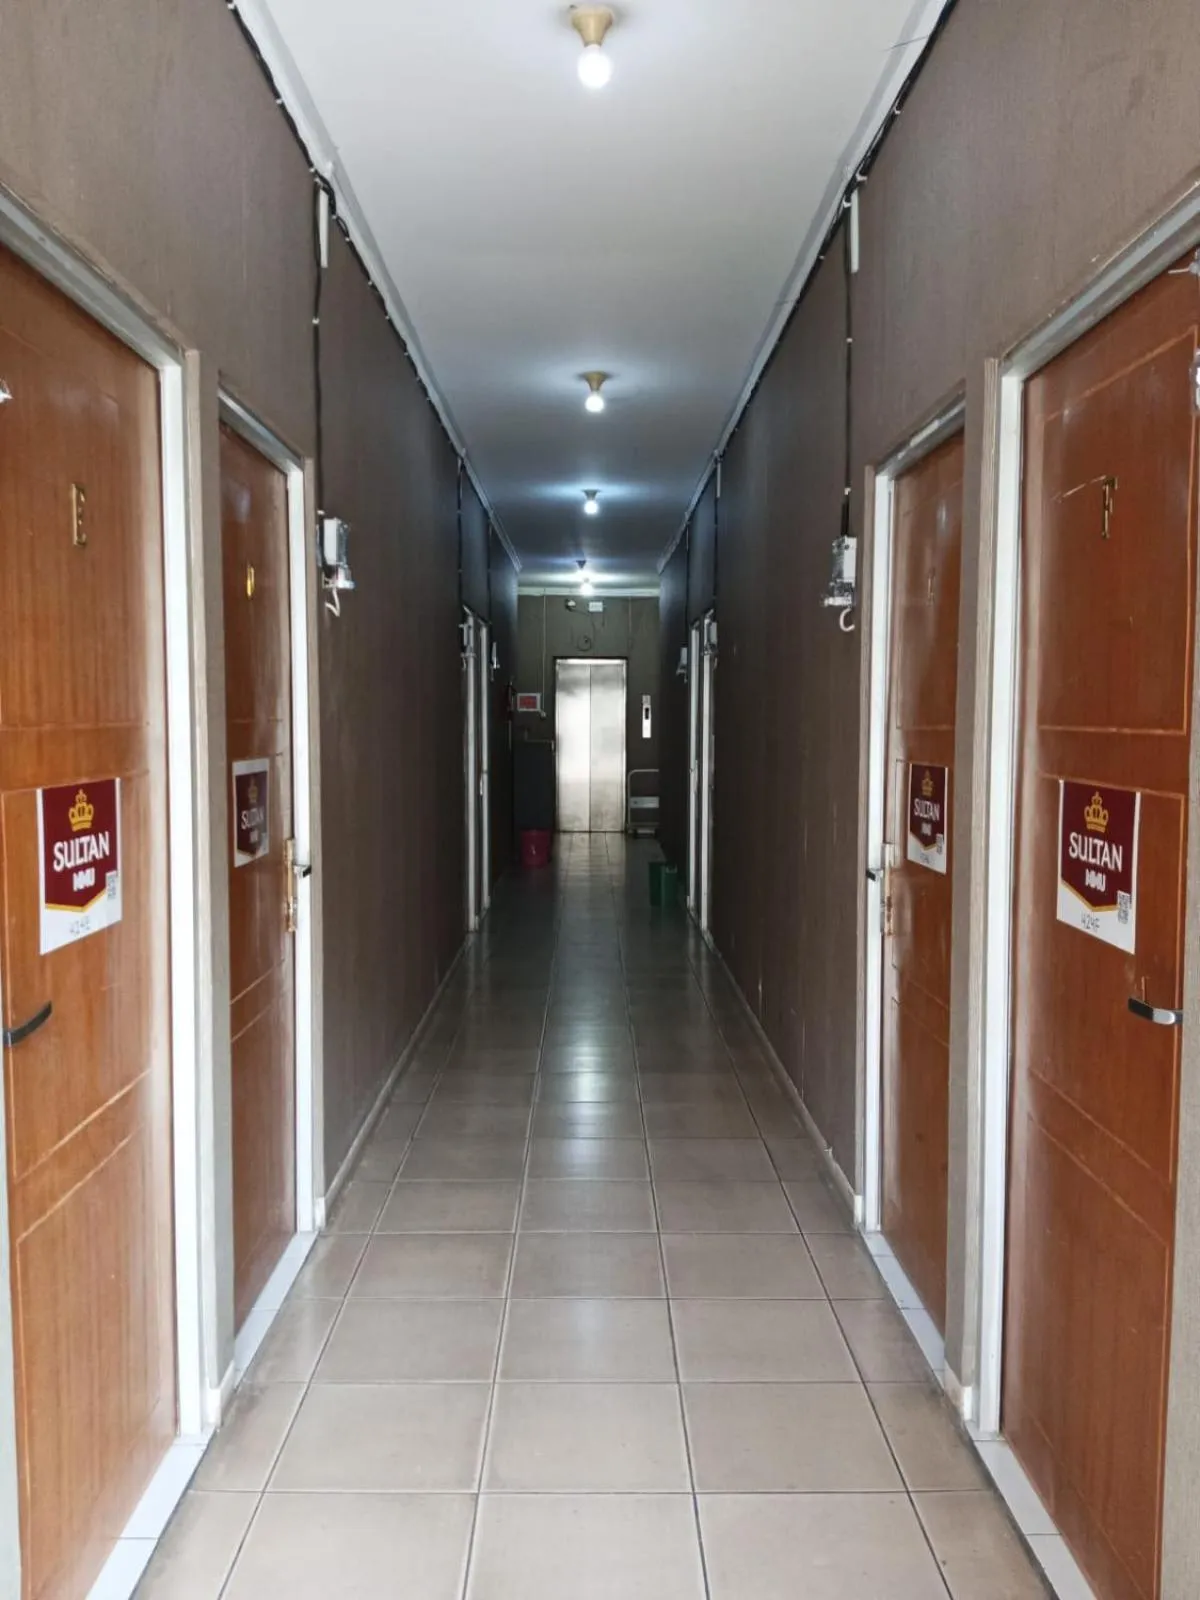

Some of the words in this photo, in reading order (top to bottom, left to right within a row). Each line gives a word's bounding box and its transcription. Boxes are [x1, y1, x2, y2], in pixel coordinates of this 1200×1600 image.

[914, 798, 940, 821] SULTAN
[53, 831, 110, 872] SULTAN
[1069, 831, 1123, 872] SULTAN
